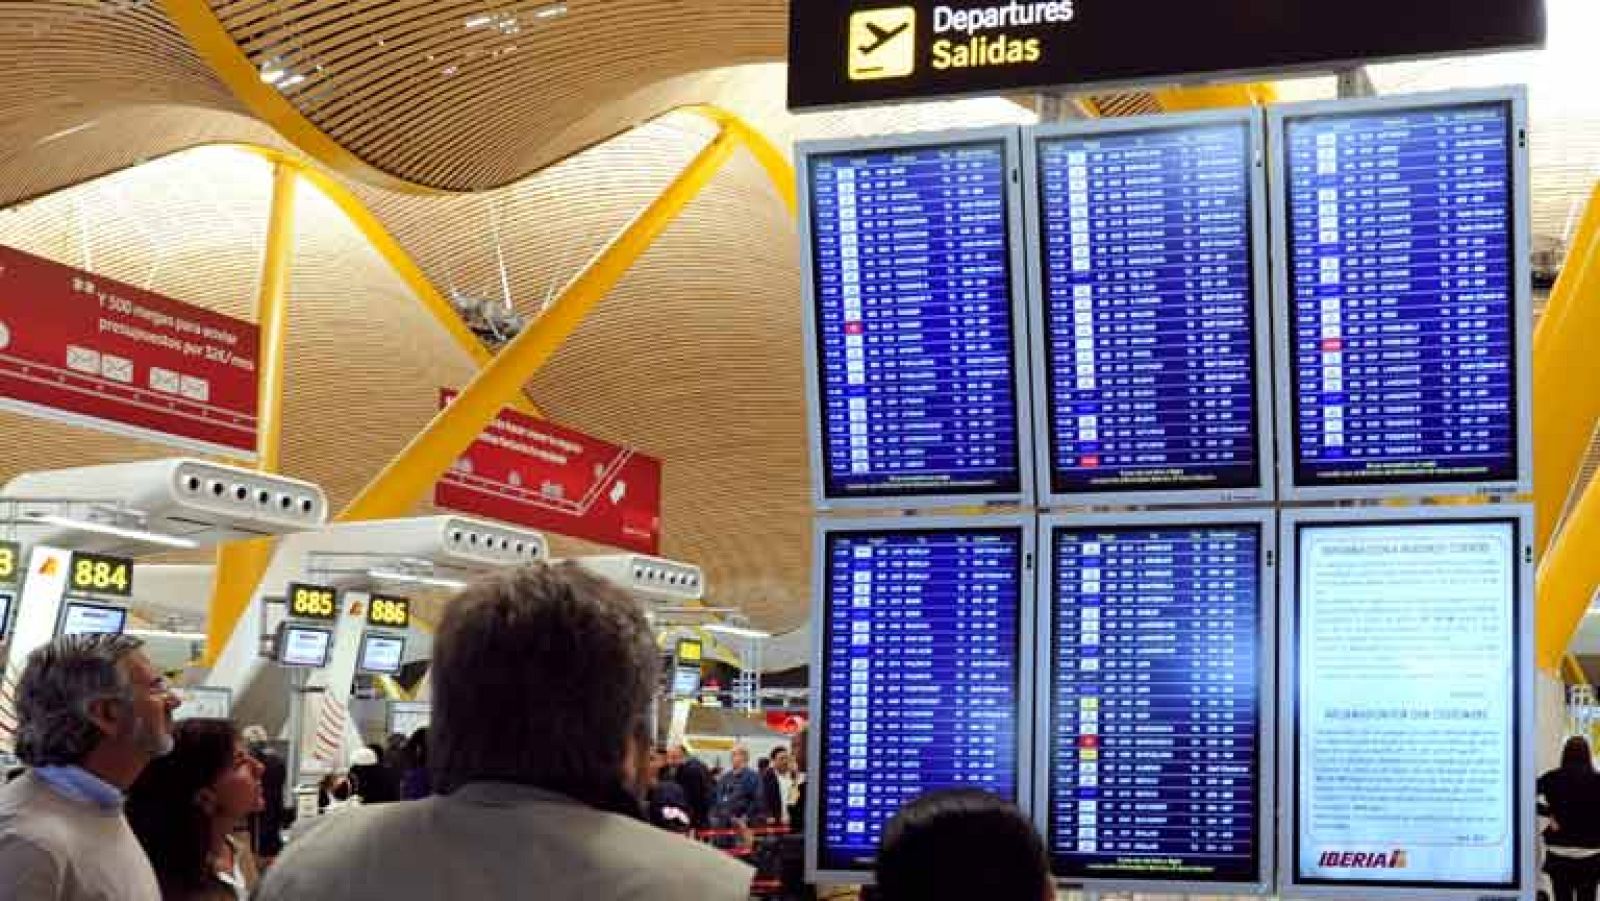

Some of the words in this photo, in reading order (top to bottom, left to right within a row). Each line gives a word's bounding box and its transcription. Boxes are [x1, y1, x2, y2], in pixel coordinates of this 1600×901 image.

[933, 0, 1073, 35] Departures
[932, 35, 1041, 70] Salidas
[75, 558, 128, 591] 884
[294, 588, 333, 616] 885
[371, 598, 407, 624] 886
[1318, 850, 1388, 868] IBERIA
